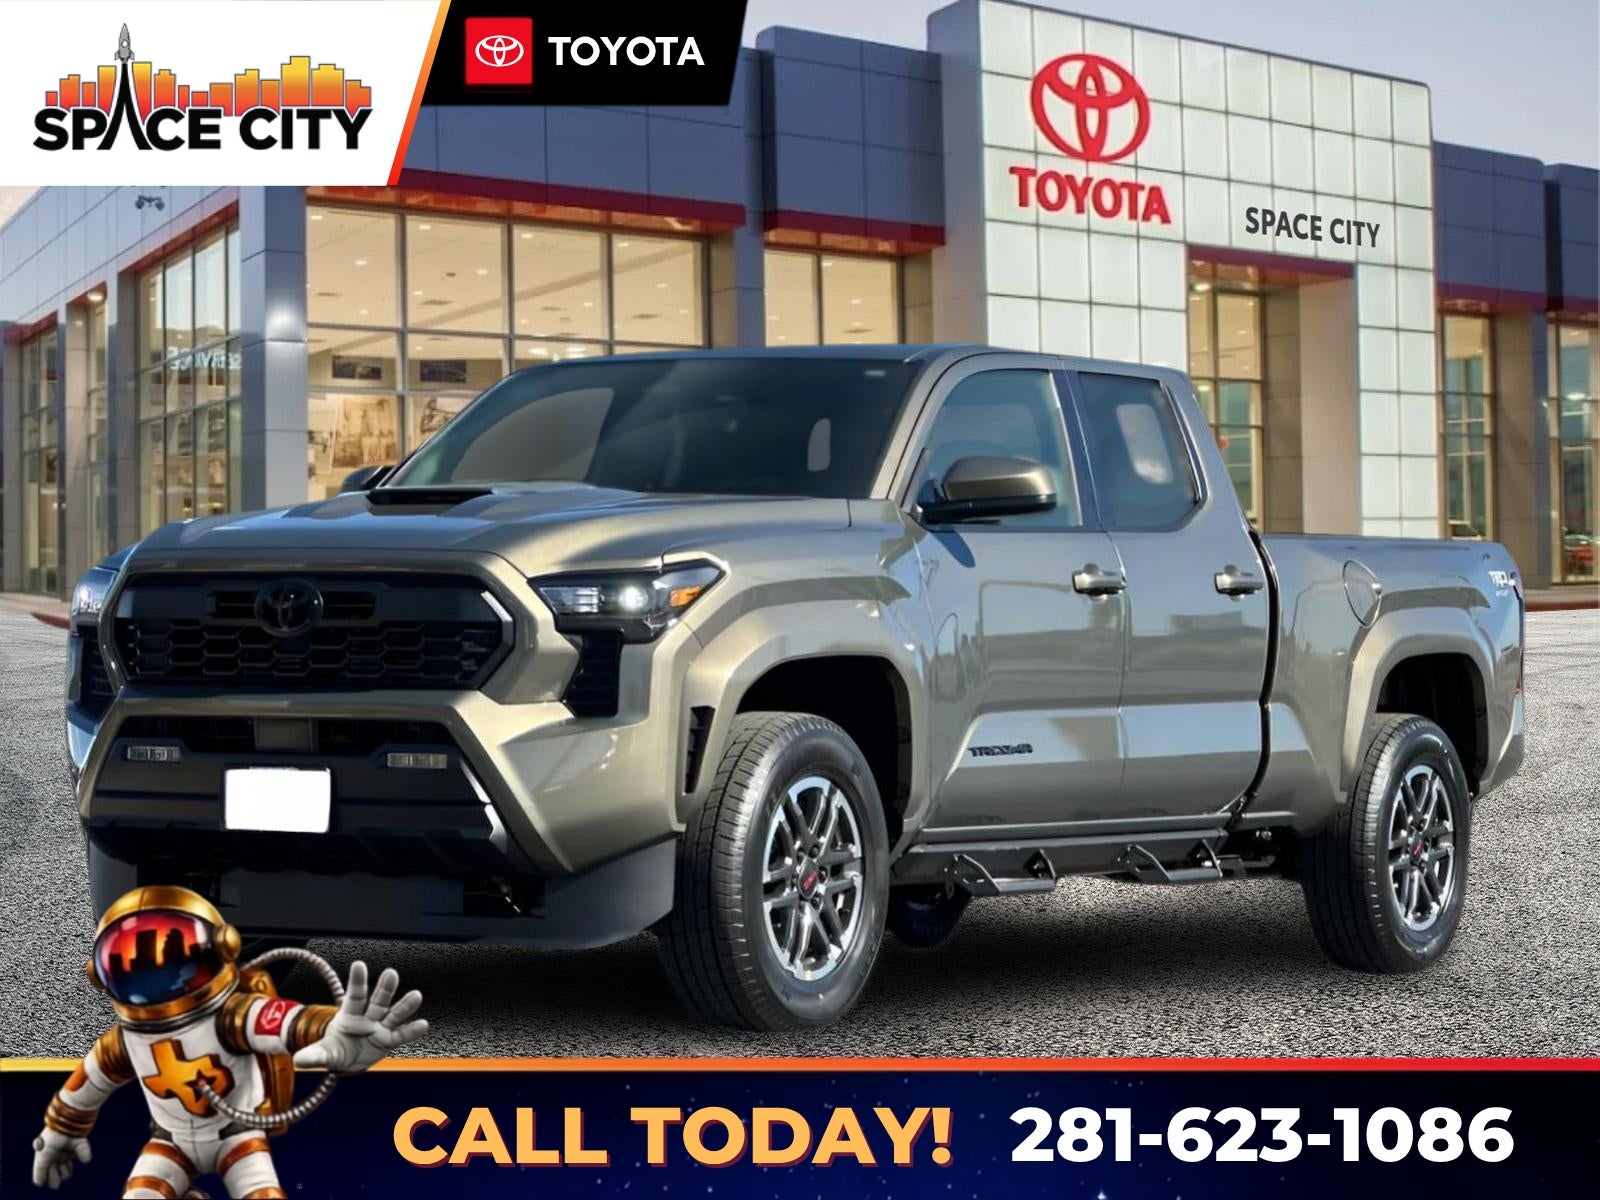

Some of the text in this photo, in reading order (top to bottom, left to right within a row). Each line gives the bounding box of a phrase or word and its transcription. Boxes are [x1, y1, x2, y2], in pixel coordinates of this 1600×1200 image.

[1009, 166, 1171, 225] TOYOTA
[1245, 206, 1381, 248] SPACE CITY
